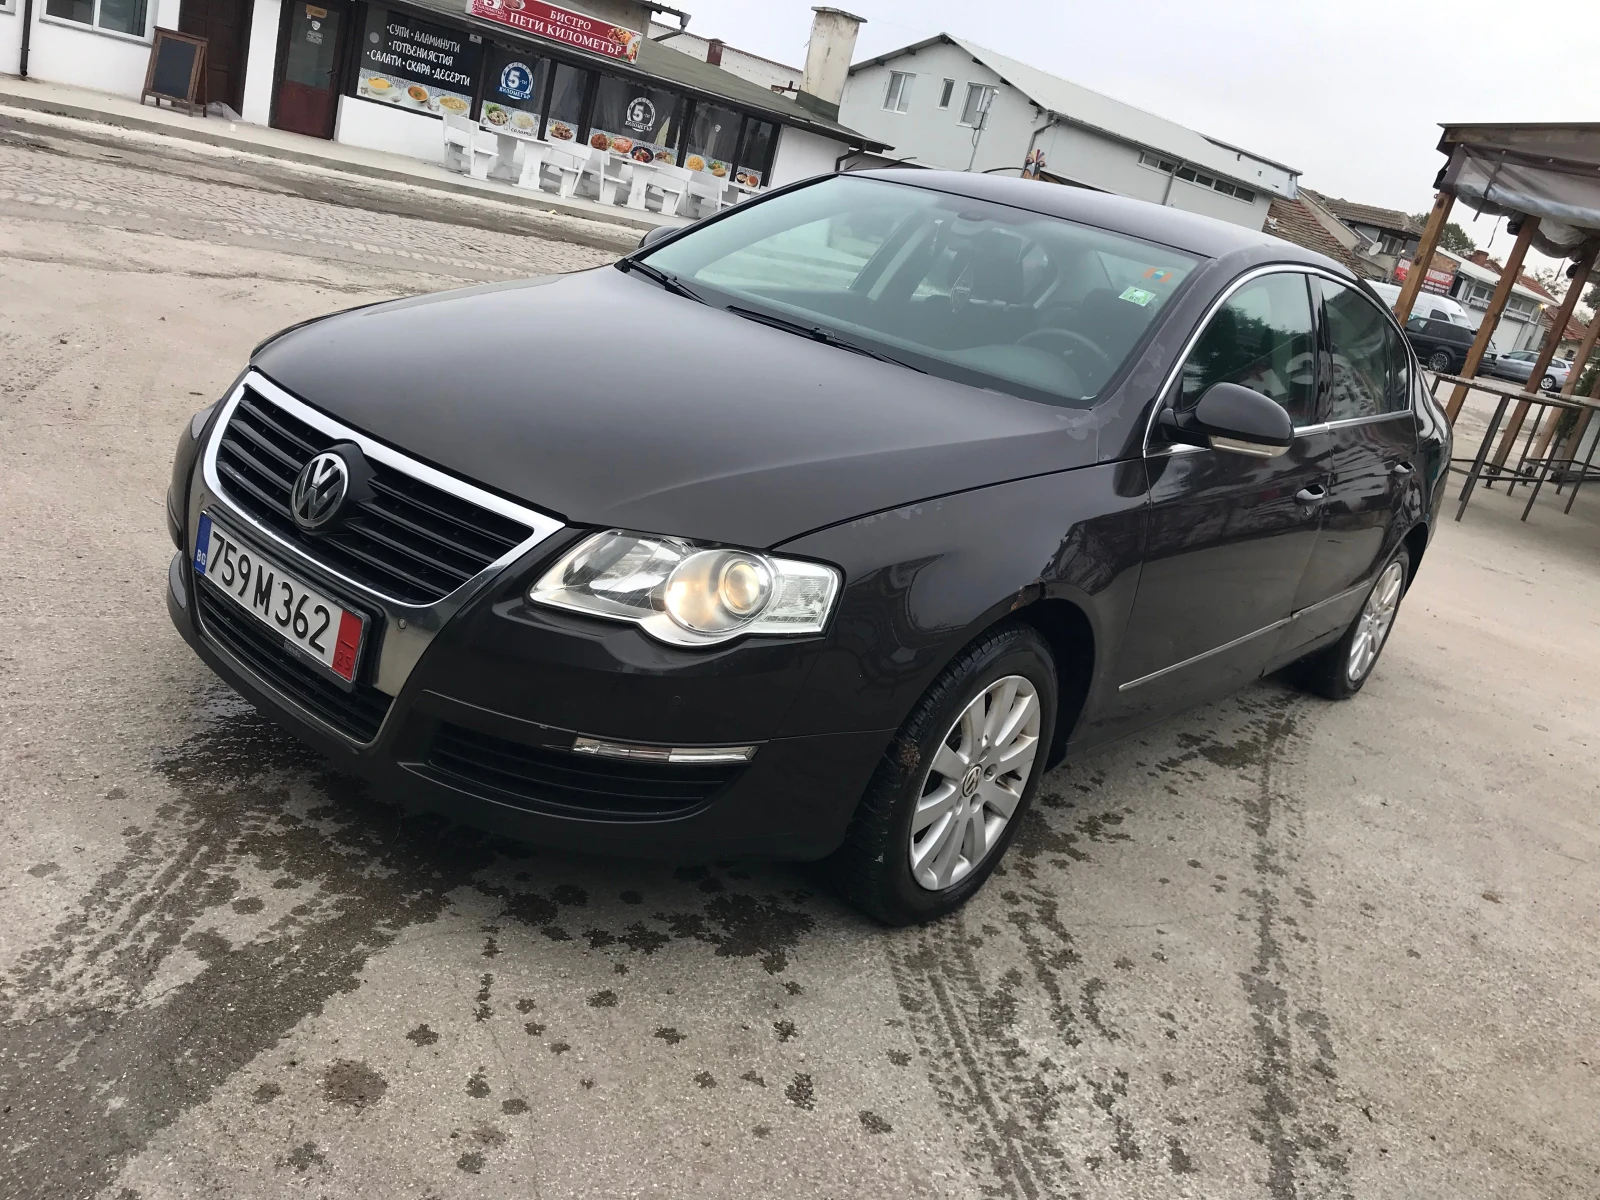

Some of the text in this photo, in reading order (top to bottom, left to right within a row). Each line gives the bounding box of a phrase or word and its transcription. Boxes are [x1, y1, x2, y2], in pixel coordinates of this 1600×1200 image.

[509, 12, 622, 55] ПЕТИ КИЛОМЕТЪР
[550, 10, 592, 31] БИСТРО
[389, 23, 461, 53] СУПИ АЛАМИНУТИ
[392, 40, 454, 66] ГОТВЕНИ ЯСТИЯ
[370, 49, 471, 86] САЛАТИ СКАРА ДЕСЕРТИ
[196, 548, 207, 566] BG
[208, 530, 331, 655] 759M362
